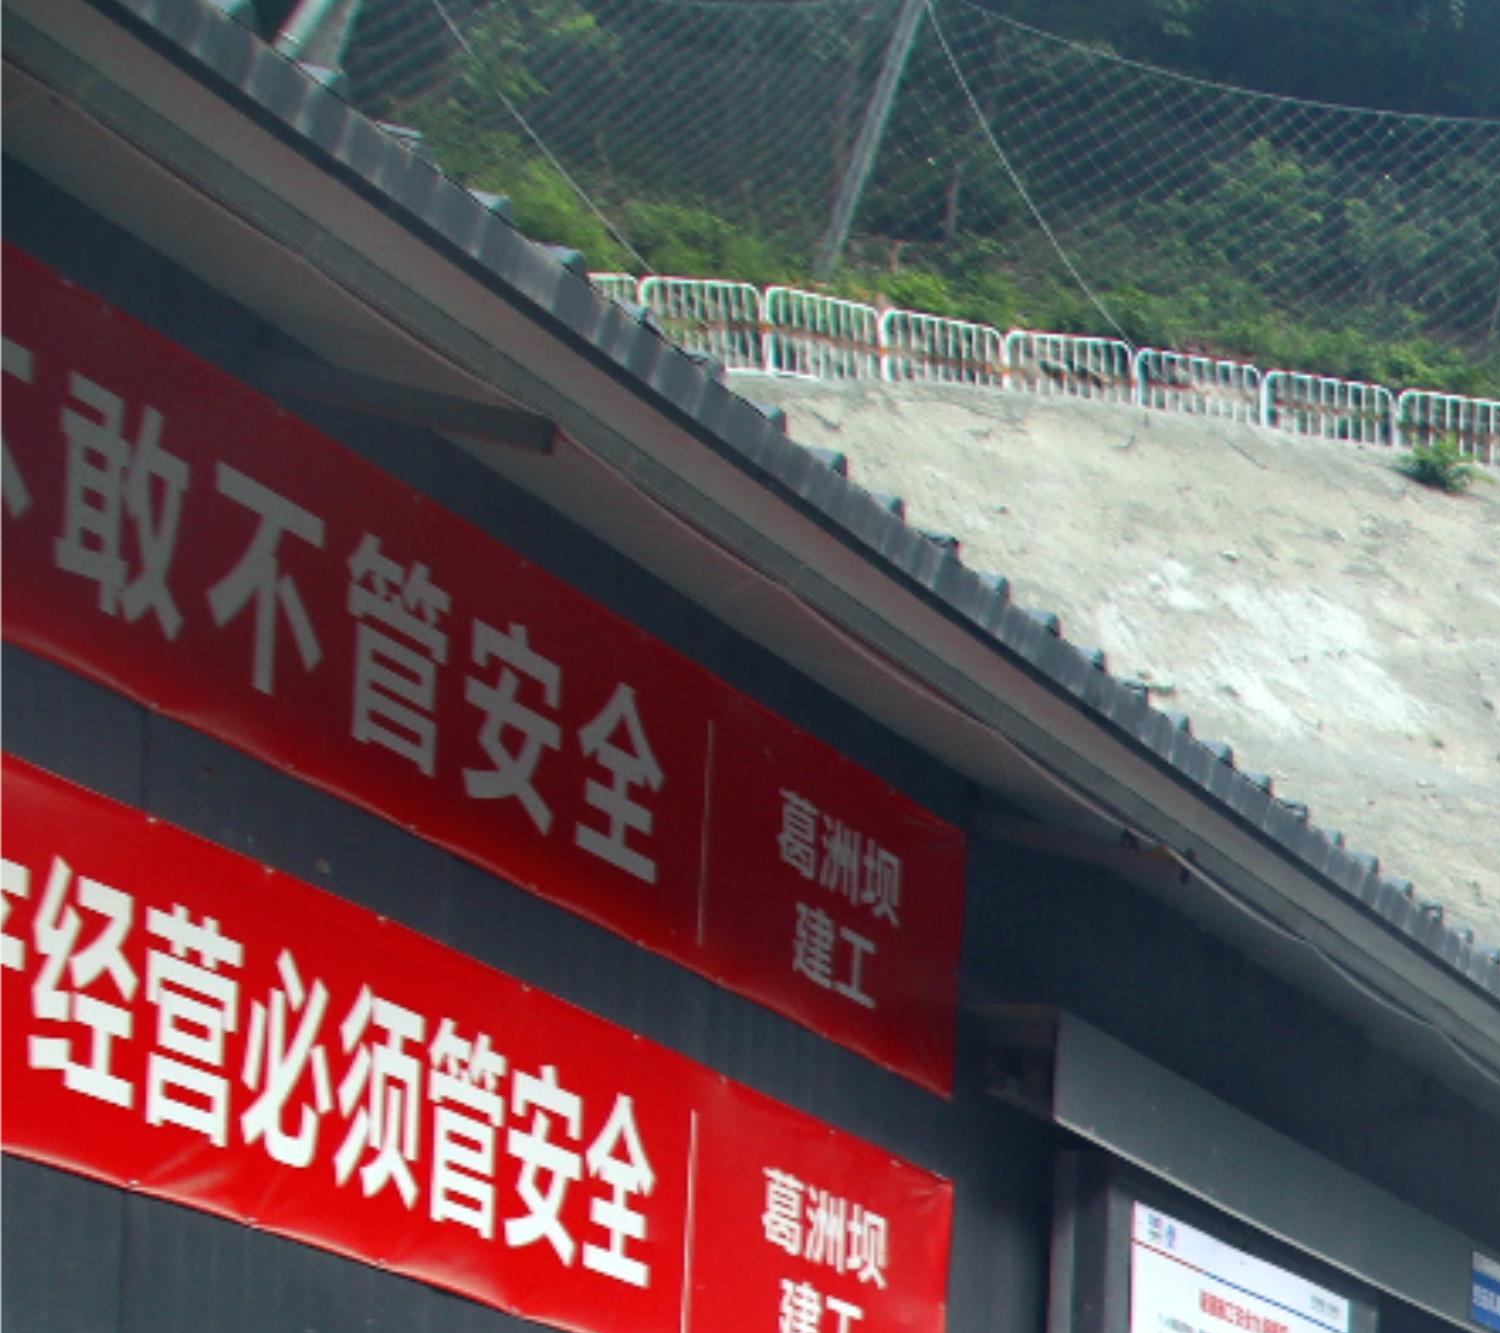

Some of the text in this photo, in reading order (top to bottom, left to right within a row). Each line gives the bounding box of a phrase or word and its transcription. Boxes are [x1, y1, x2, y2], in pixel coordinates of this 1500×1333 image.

[777, 788, 903, 926] 葛洲坝
[791, 900, 879, 1009] 建工
[763, 1166, 889, 1290] 葛洲坝
